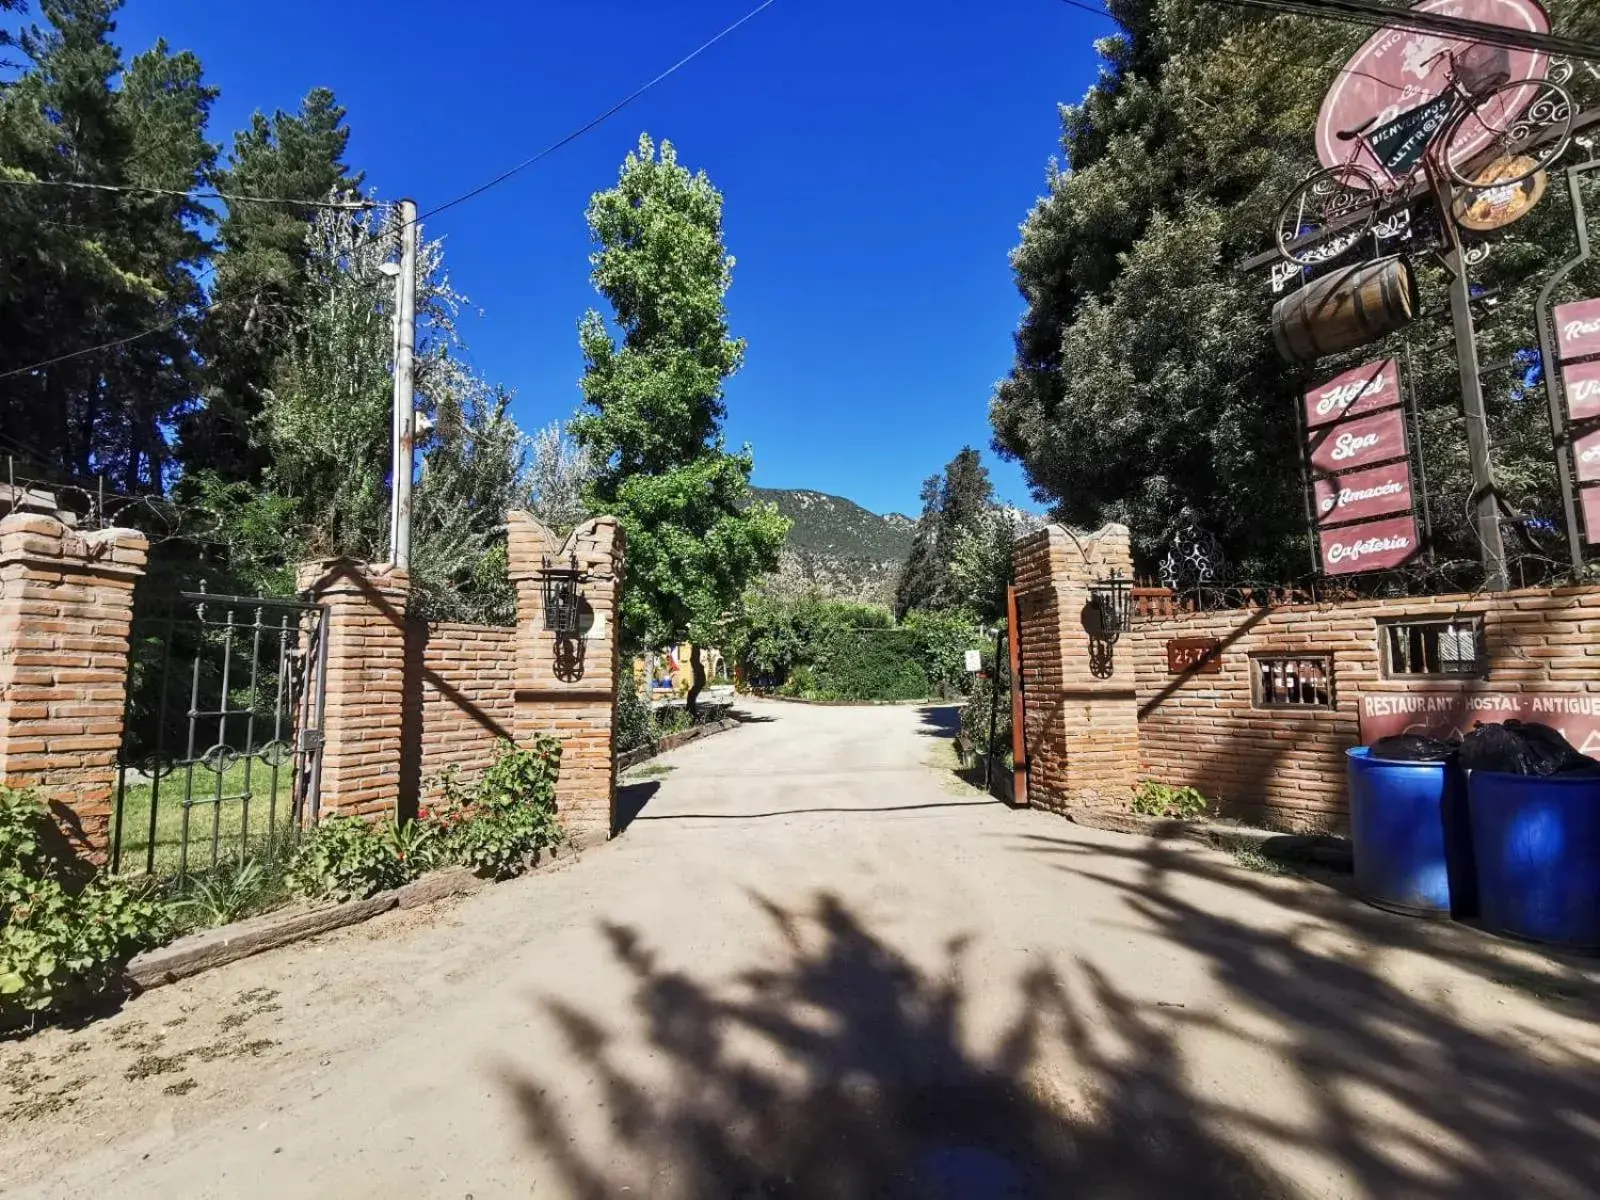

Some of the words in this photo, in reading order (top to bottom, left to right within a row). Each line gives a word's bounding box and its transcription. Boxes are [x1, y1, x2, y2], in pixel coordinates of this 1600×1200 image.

[1316, 373, 1385, 416] Hotel
[1331, 433, 1379, 460] Spa
[1321, 480, 1403, 512] Almacén
[1365, 695, 1453, 717] RESTAURANT
[1465, 694, 1521, 712] HOSTAL
